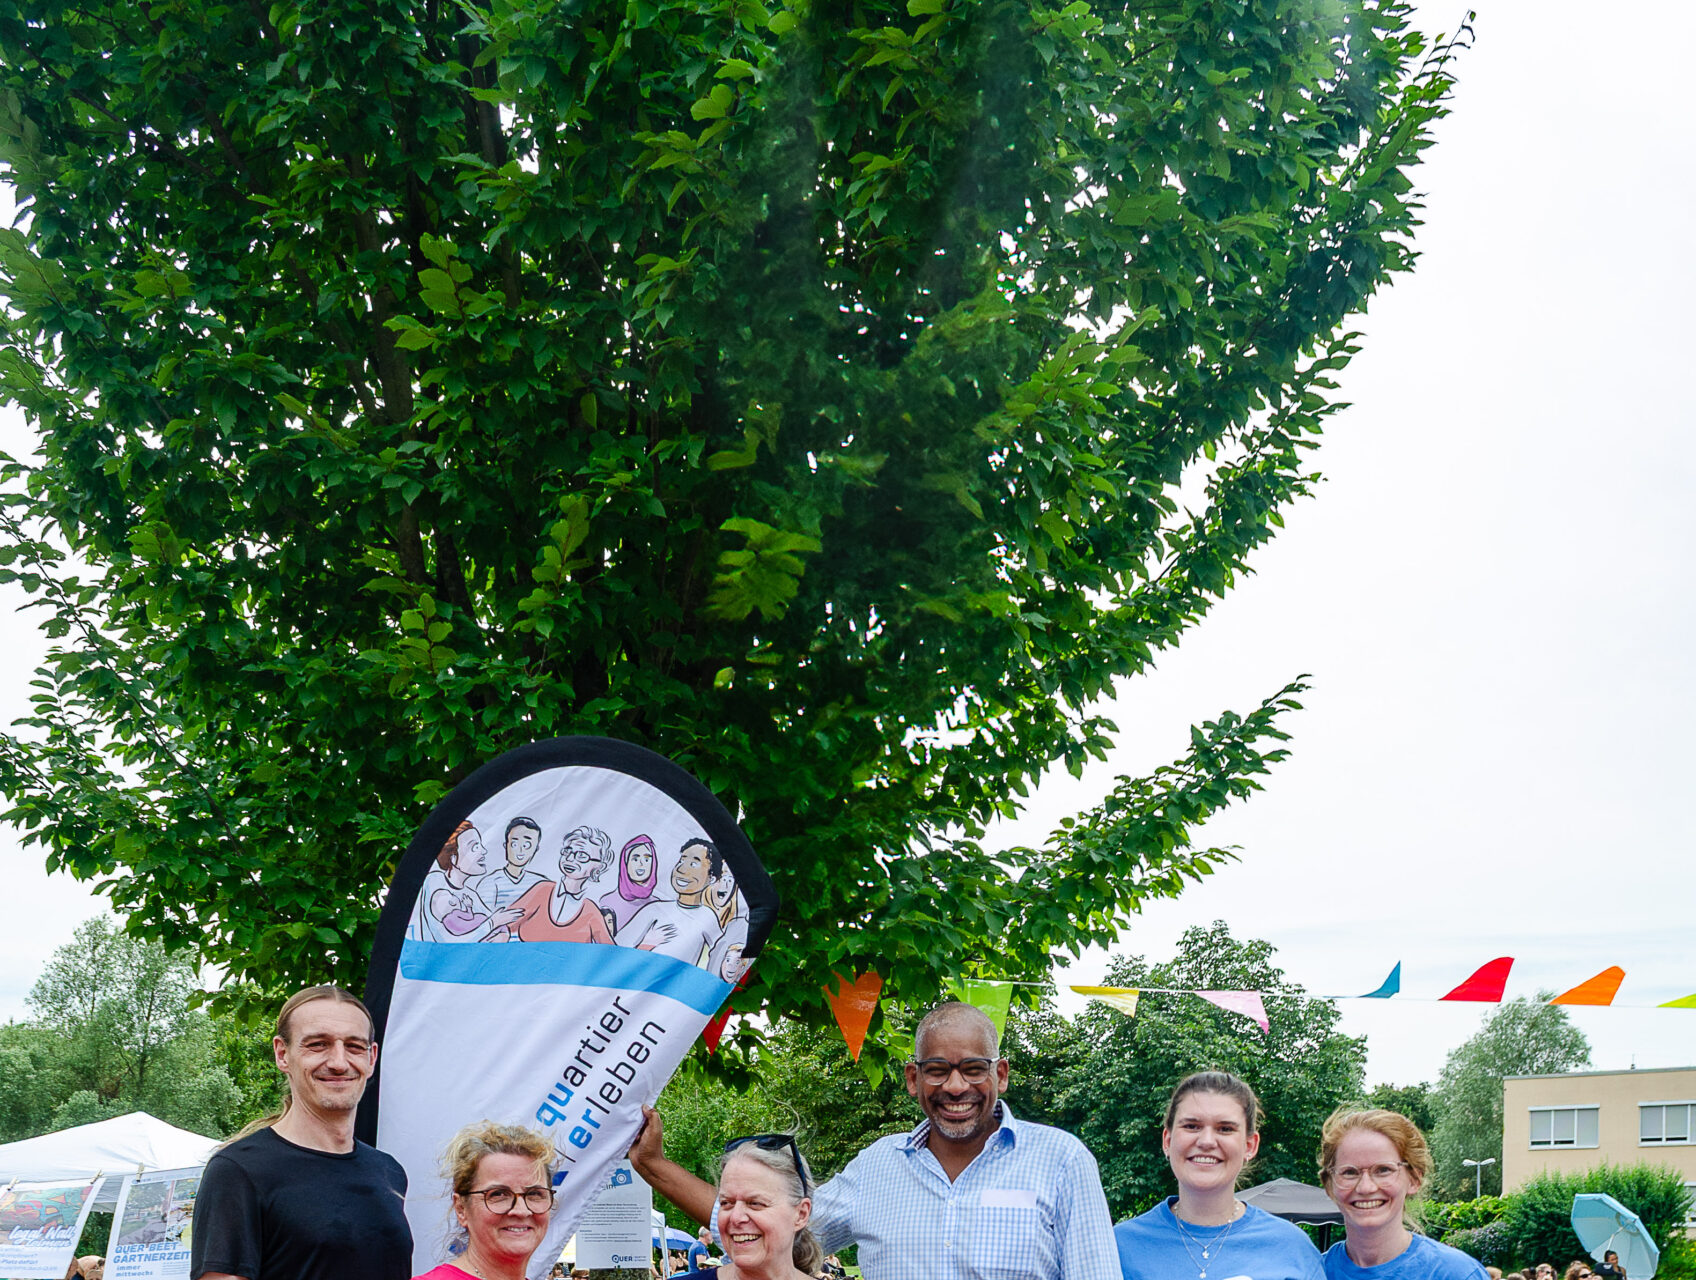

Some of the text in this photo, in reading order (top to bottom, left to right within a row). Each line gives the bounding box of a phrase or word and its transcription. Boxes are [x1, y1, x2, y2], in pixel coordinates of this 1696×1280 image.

[536, 996, 630, 1127] quartier
[568, 1021, 666, 1149] erleben
[115, 1242, 179, 1254] QUER BEET
[612, 1254, 633, 1263] QUER
